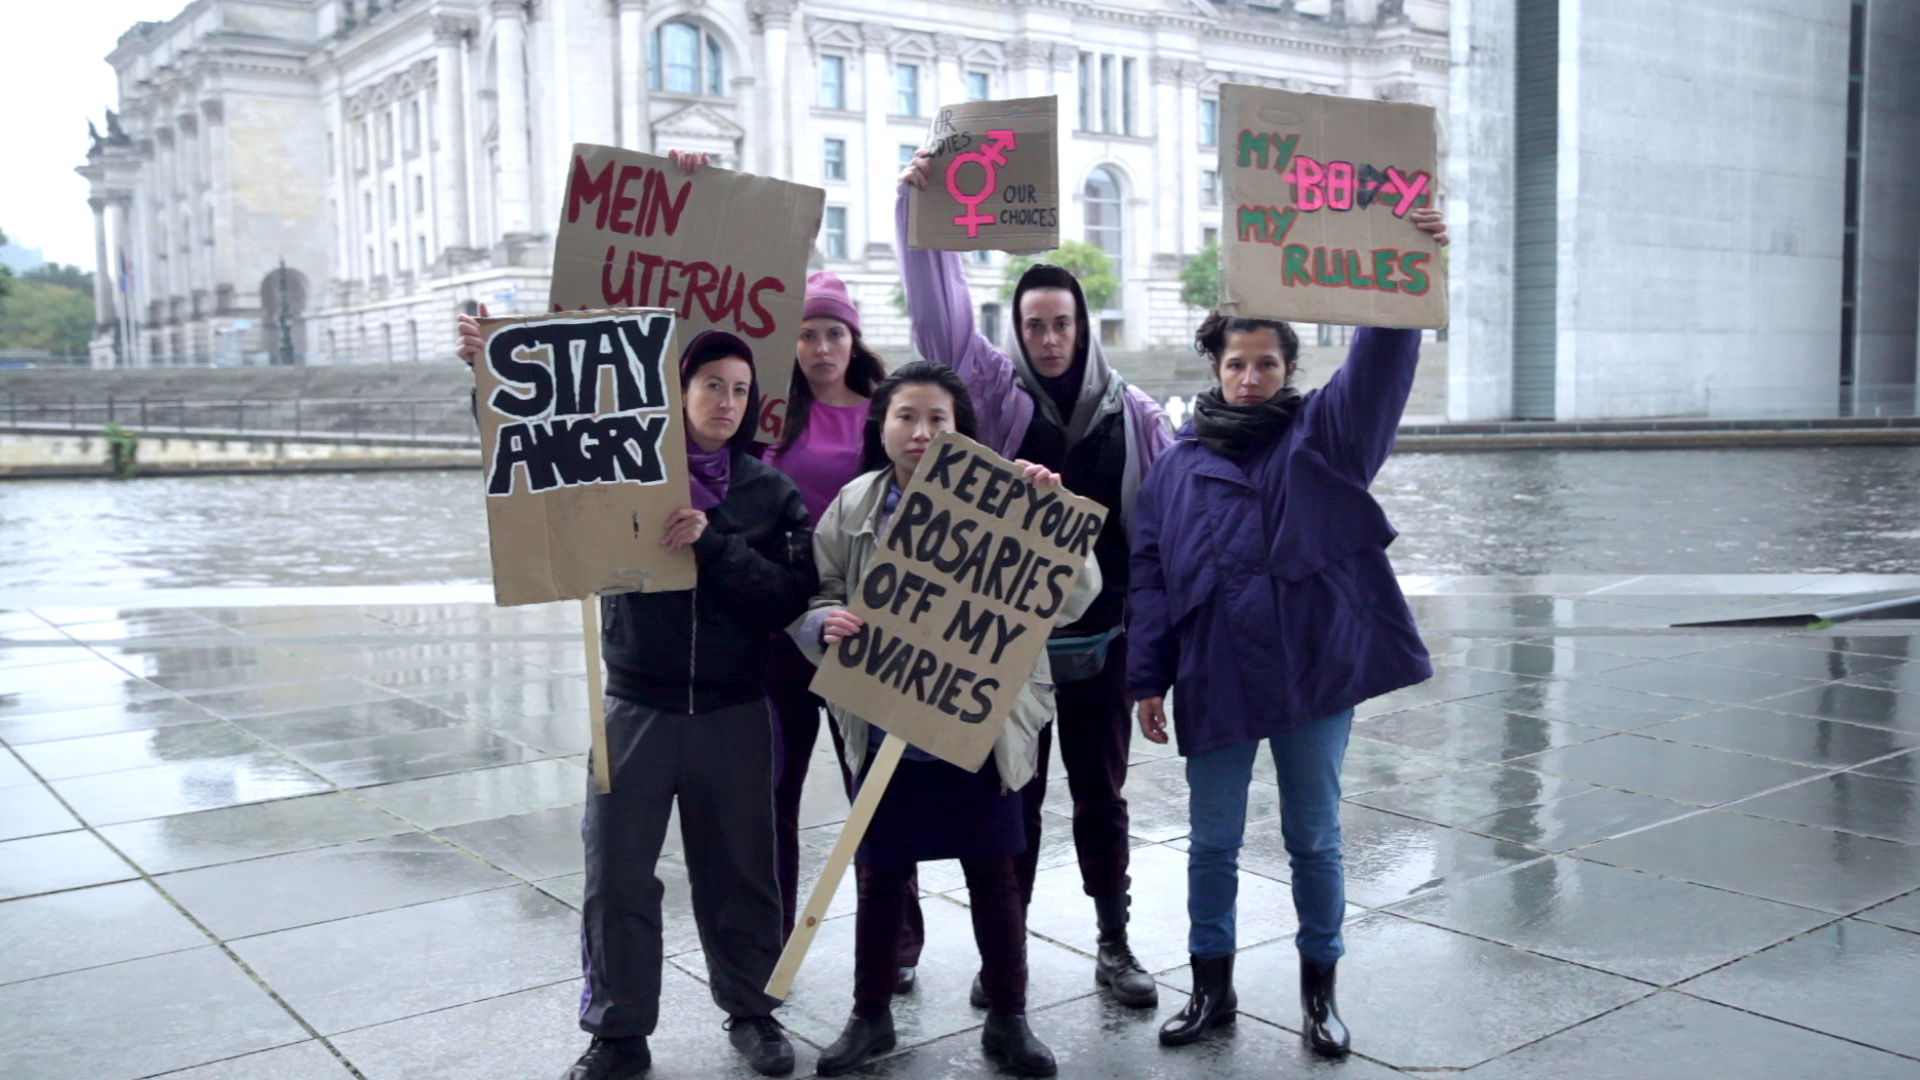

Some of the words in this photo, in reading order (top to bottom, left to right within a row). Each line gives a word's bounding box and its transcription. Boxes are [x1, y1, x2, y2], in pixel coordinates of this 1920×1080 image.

[930, 131, 972, 157] DIES
[935, 110, 957, 135] UR
[1237, 129, 1300, 174] MY
[568, 154, 692, 237] MEIN
[1000, 208, 1057, 227] CHOICES
[1003, 184, 1038, 204] OUR
[1237, 204, 1299, 246] MY
[602, 245, 786, 339] UTERUS
[1281, 243, 1431, 297] RULES
[485, 312, 676, 420] STAY
[486, 413, 670, 497] ANGRY
[887, 491, 1073, 619] ROSARIES
[863, 562, 946, 624] OFF
[942, 601, 1027, 664] MY
[838, 622, 1000, 724] OVARIES
